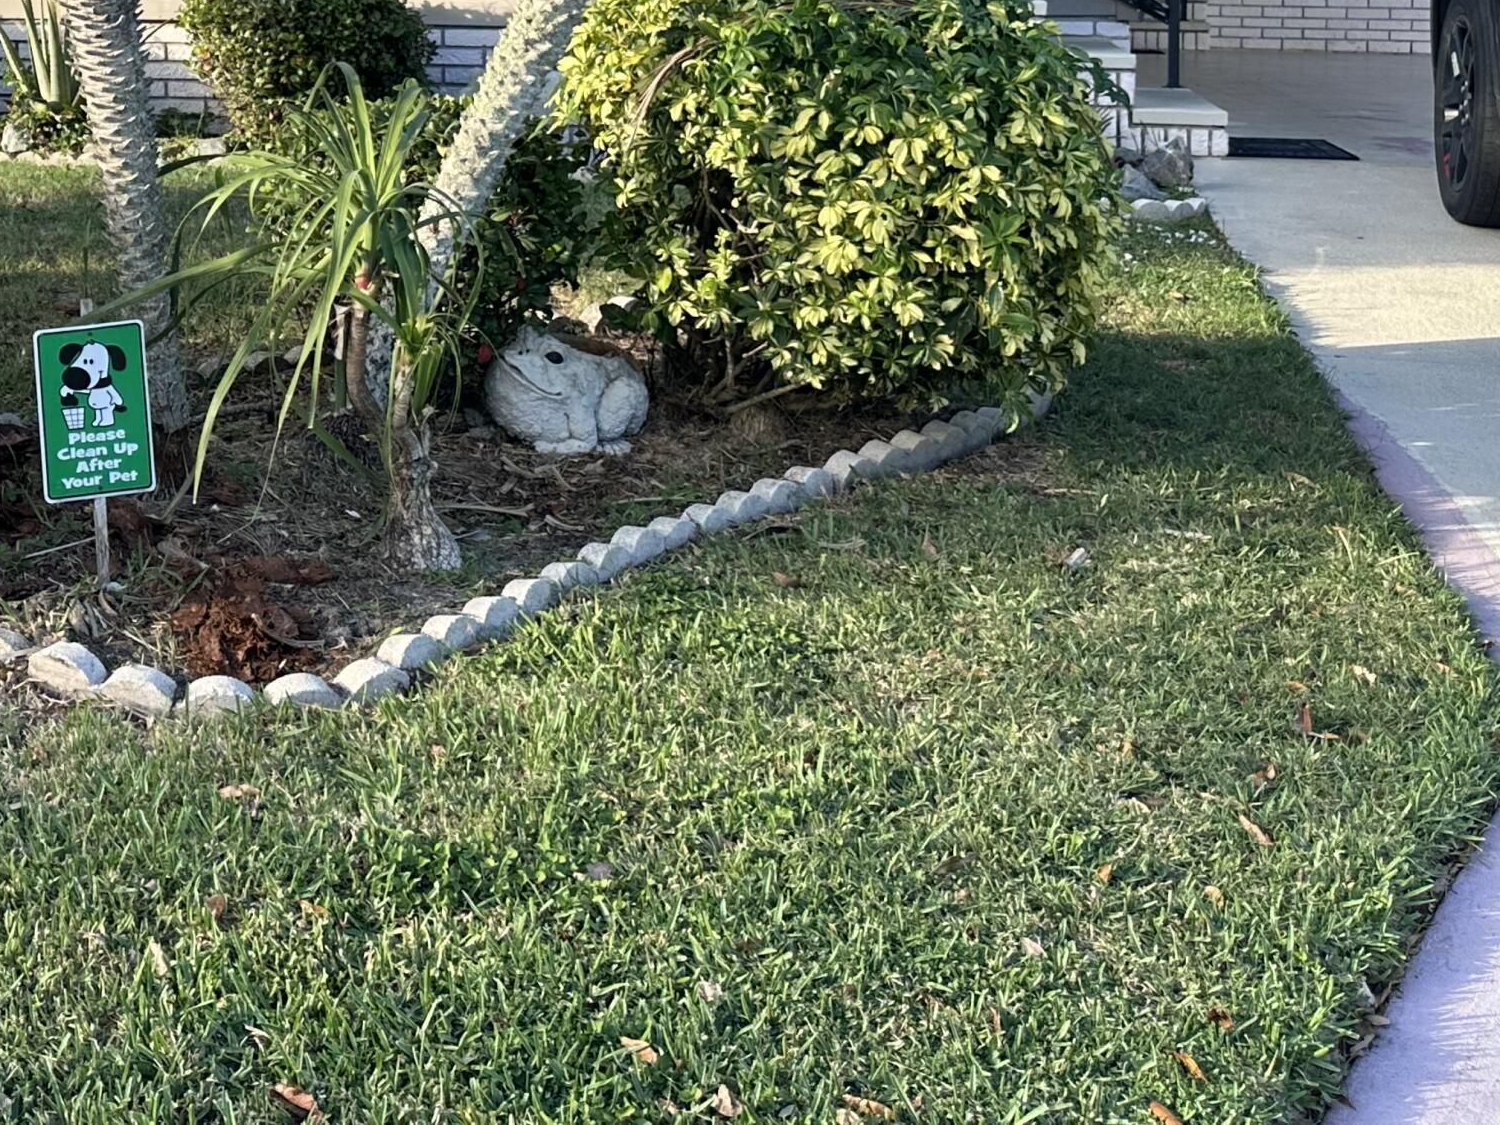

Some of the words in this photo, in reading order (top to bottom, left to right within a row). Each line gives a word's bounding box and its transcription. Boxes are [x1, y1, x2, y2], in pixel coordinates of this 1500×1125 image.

[68, 429, 126, 445] Please
[57, 446, 107, 460] Clean
[113, 442, 138, 455] Up
[76, 458, 122, 473] After
[61, 475, 103, 489] Your
[109, 470, 138, 483] Pet
